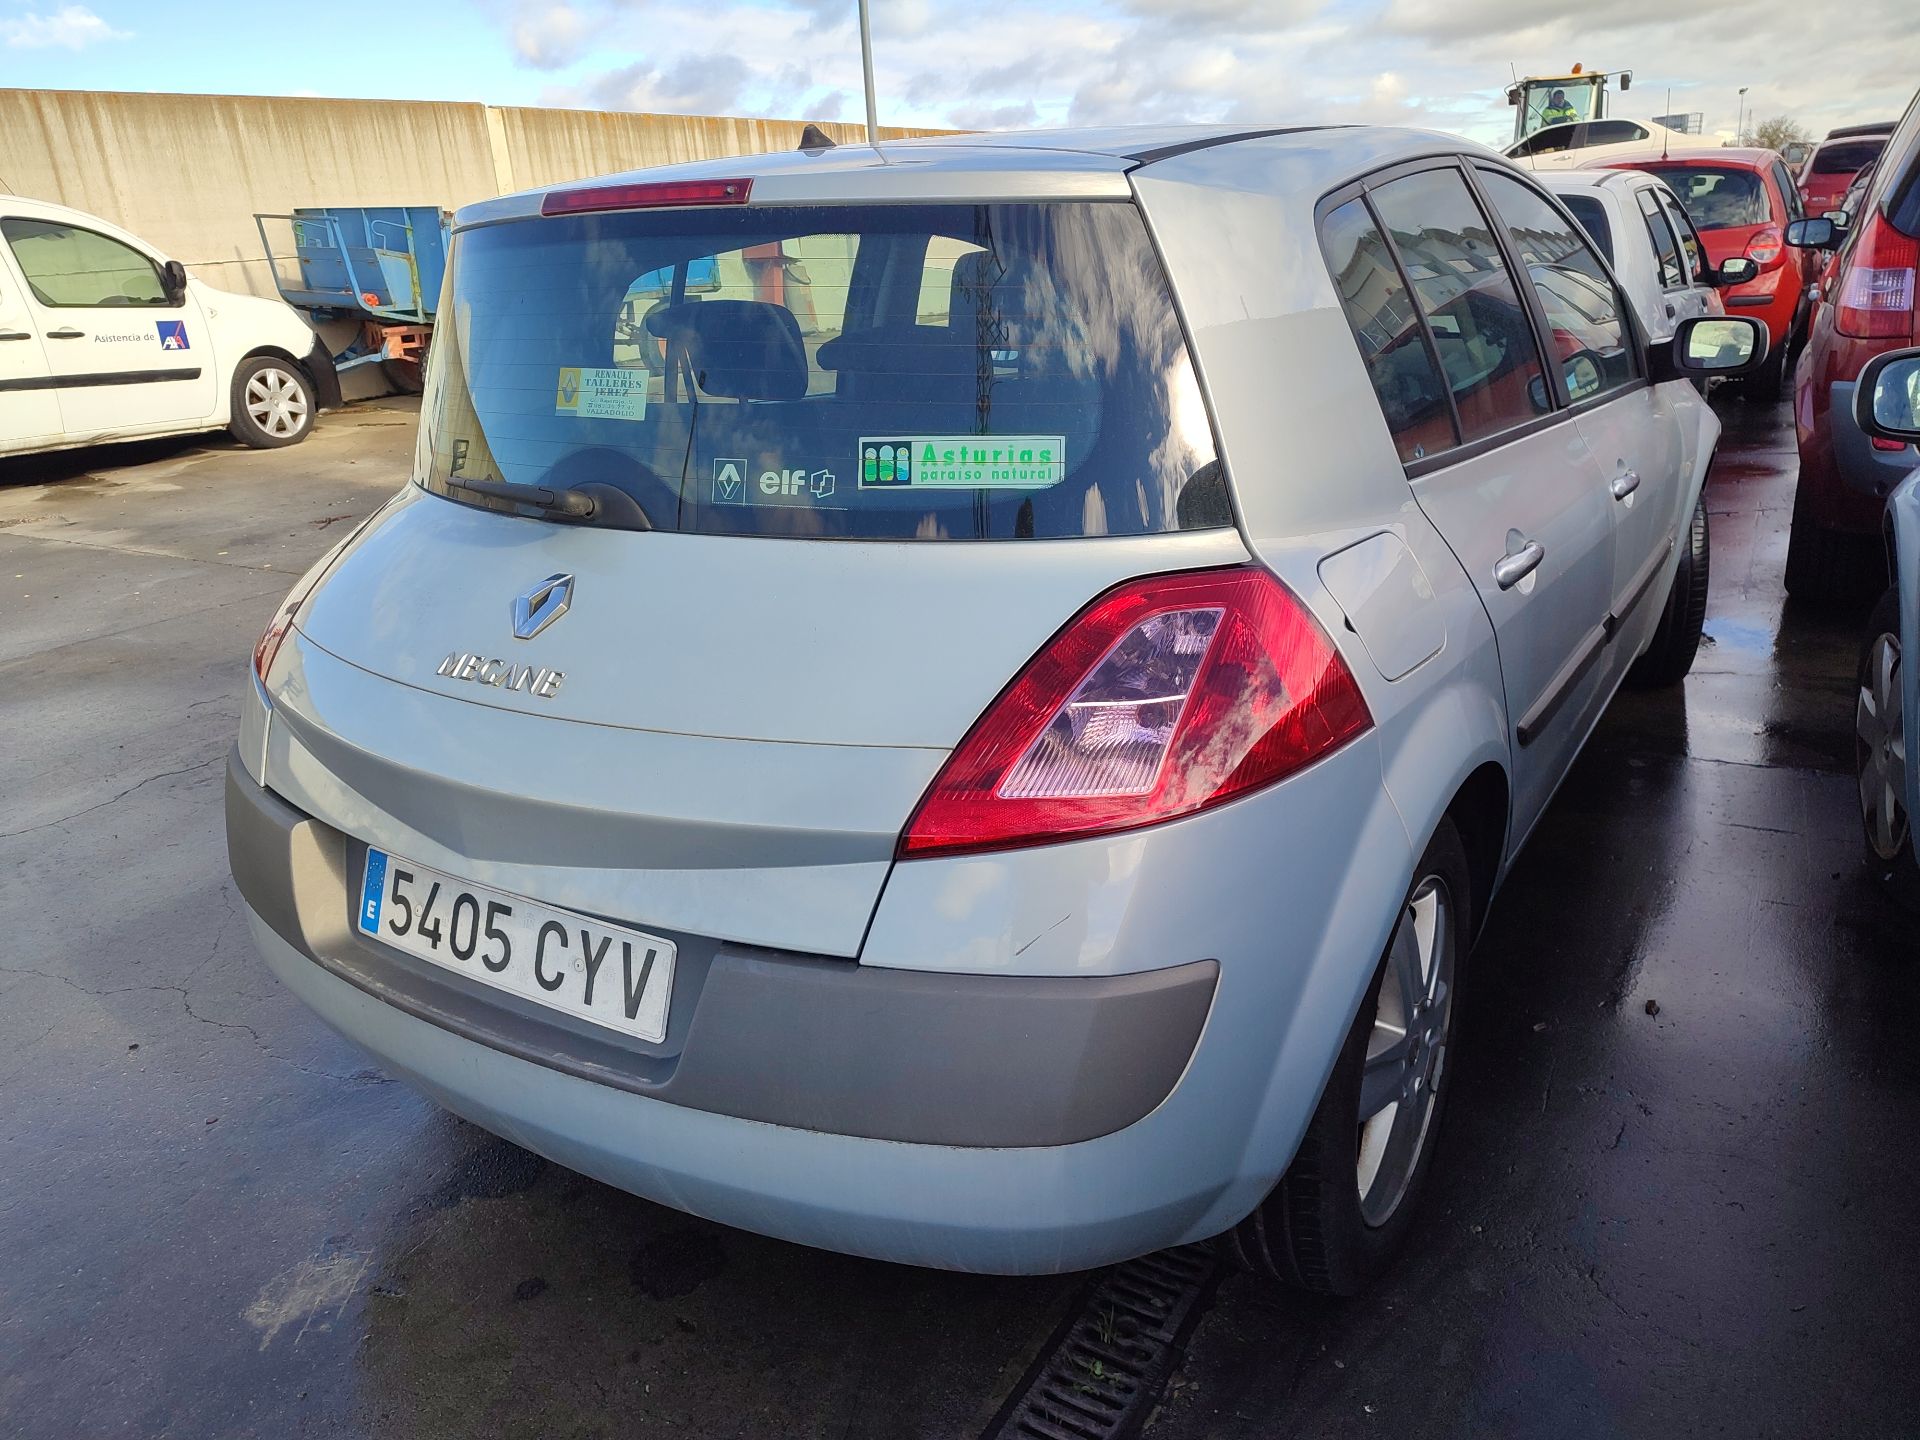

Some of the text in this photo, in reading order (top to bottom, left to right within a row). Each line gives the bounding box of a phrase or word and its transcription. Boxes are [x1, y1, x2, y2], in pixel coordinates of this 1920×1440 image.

[94, 333, 186, 349] Asistencia de AXA
[595, 370, 634, 379] RENAULT
[584, 378, 642, 389] TALLERES
[594, 387, 630, 398] JEREZ
[586, 408, 635, 417] VALLADOLID
[921, 443, 1052, 466] Asturias
[991, 467, 1052, 480] natural
[759, 469, 806, 496] elf
[436, 651, 568, 698] MEGANE
[366, 899, 377, 920] E
[388, 868, 658, 1020] 5405 CYV
